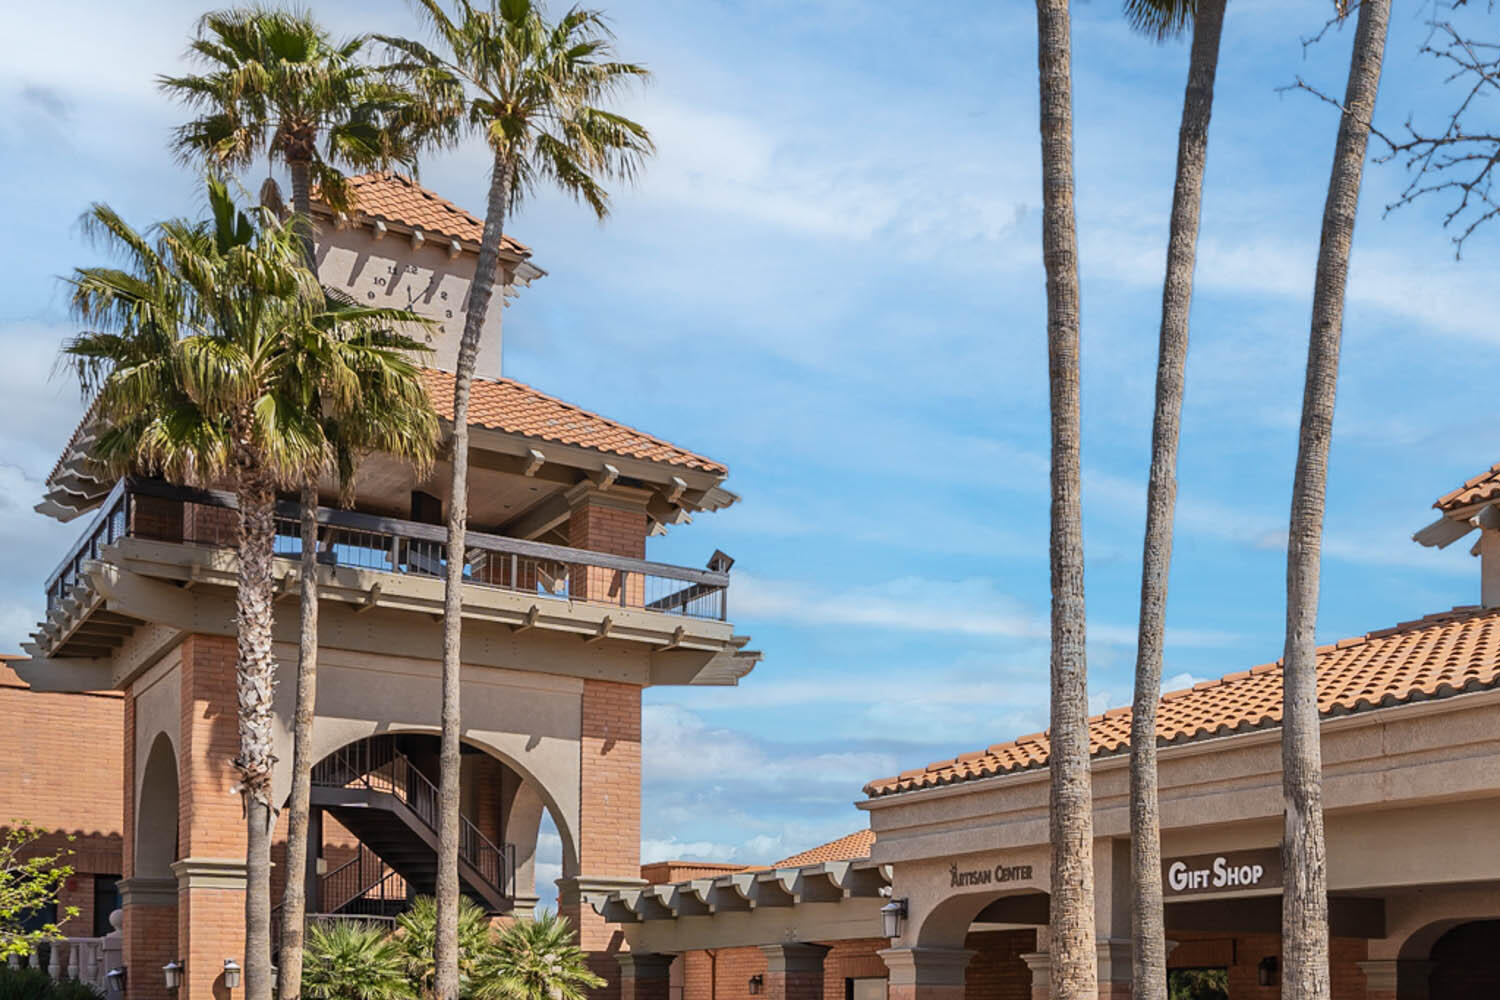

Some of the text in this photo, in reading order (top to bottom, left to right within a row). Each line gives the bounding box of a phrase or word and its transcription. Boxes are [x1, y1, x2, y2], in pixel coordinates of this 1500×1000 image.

[387, 266, 398, 275] 11
[404, 264, 418, 275] 12
[373, 276, 386, 287] 10
[367, 290, 376, 300] 9
[440, 291, 448, 301] 2
[950, 864, 1033, 888] ARTISAN CENTER
[1168, 857, 1264, 891] GIFT SHOP
